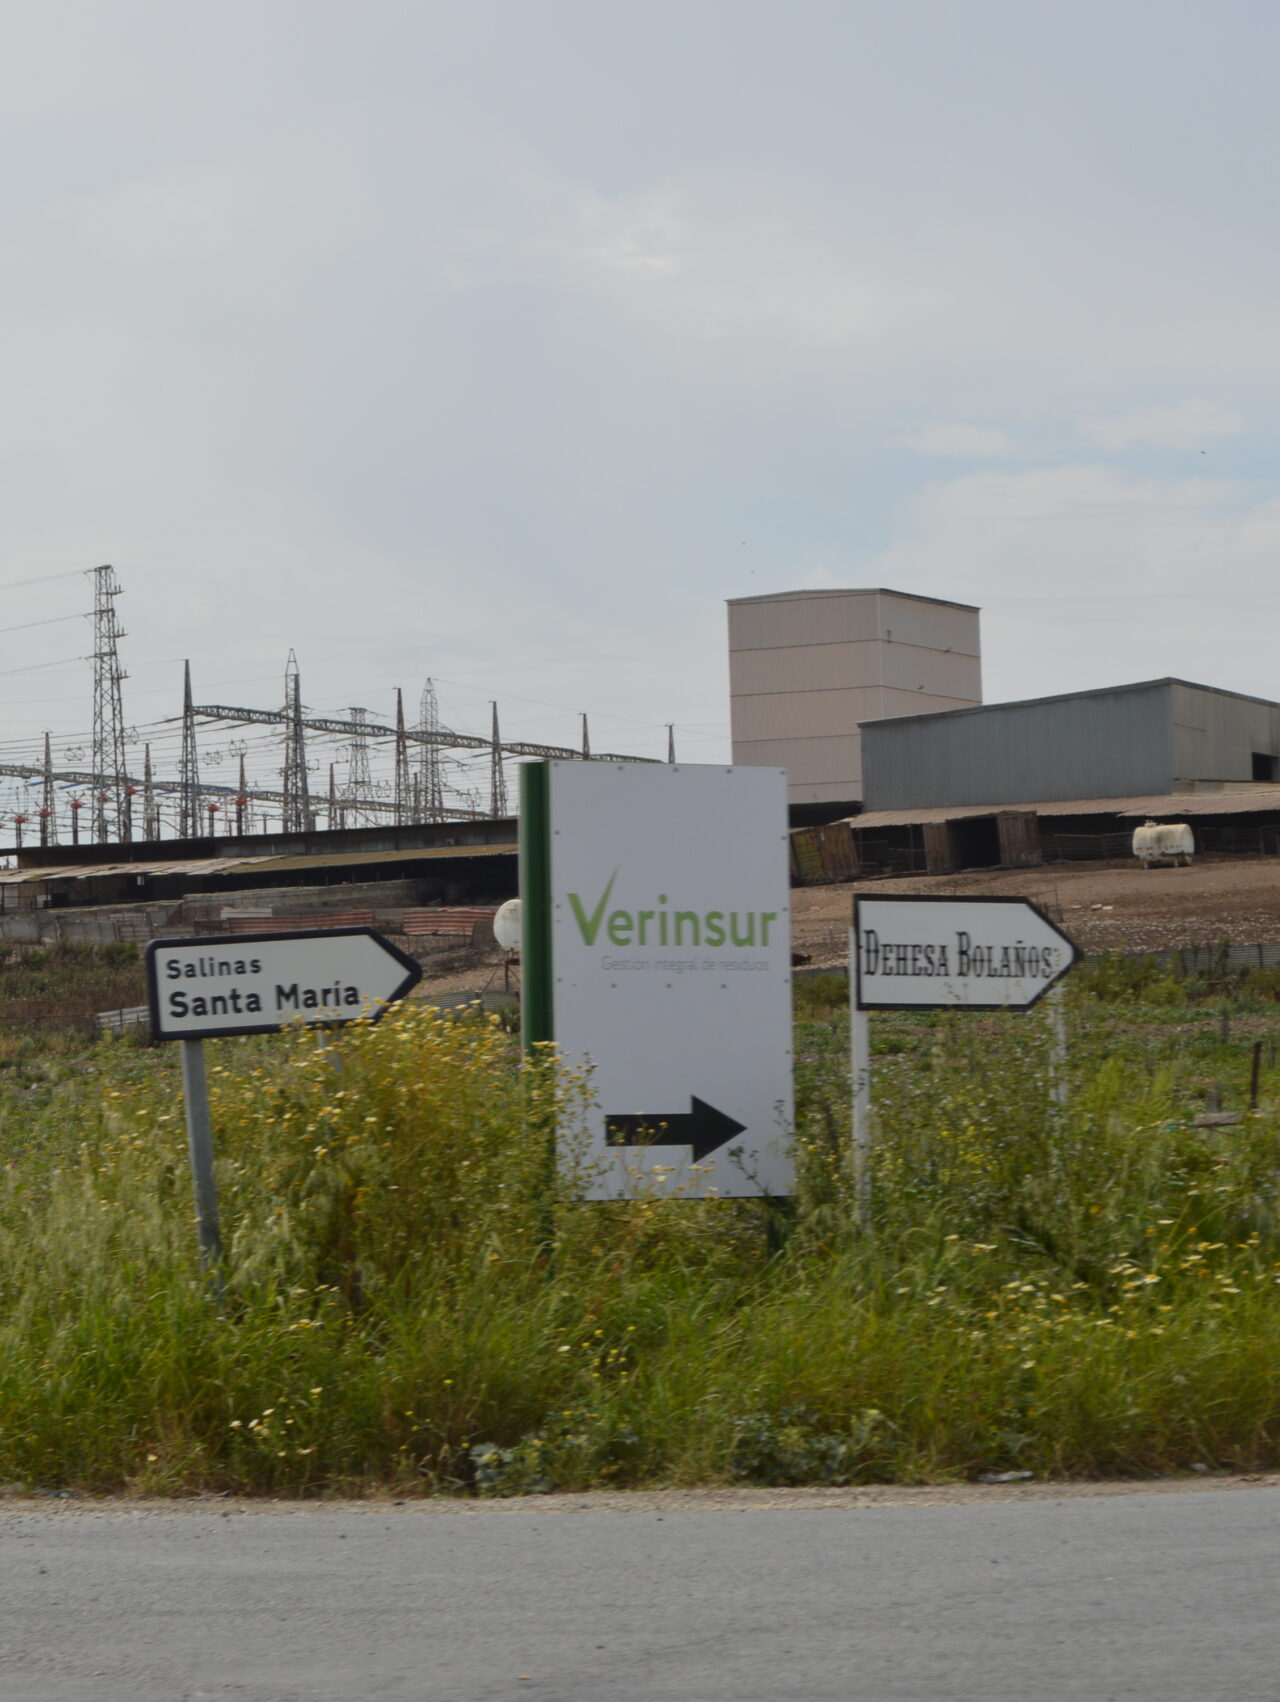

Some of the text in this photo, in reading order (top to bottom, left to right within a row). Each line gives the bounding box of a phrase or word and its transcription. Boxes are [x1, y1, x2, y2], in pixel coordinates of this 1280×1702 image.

[566, 865, 778, 947] Verinsur
[166, 957, 262, 980] Salinas
[169, 980, 360, 1018] Santa María
